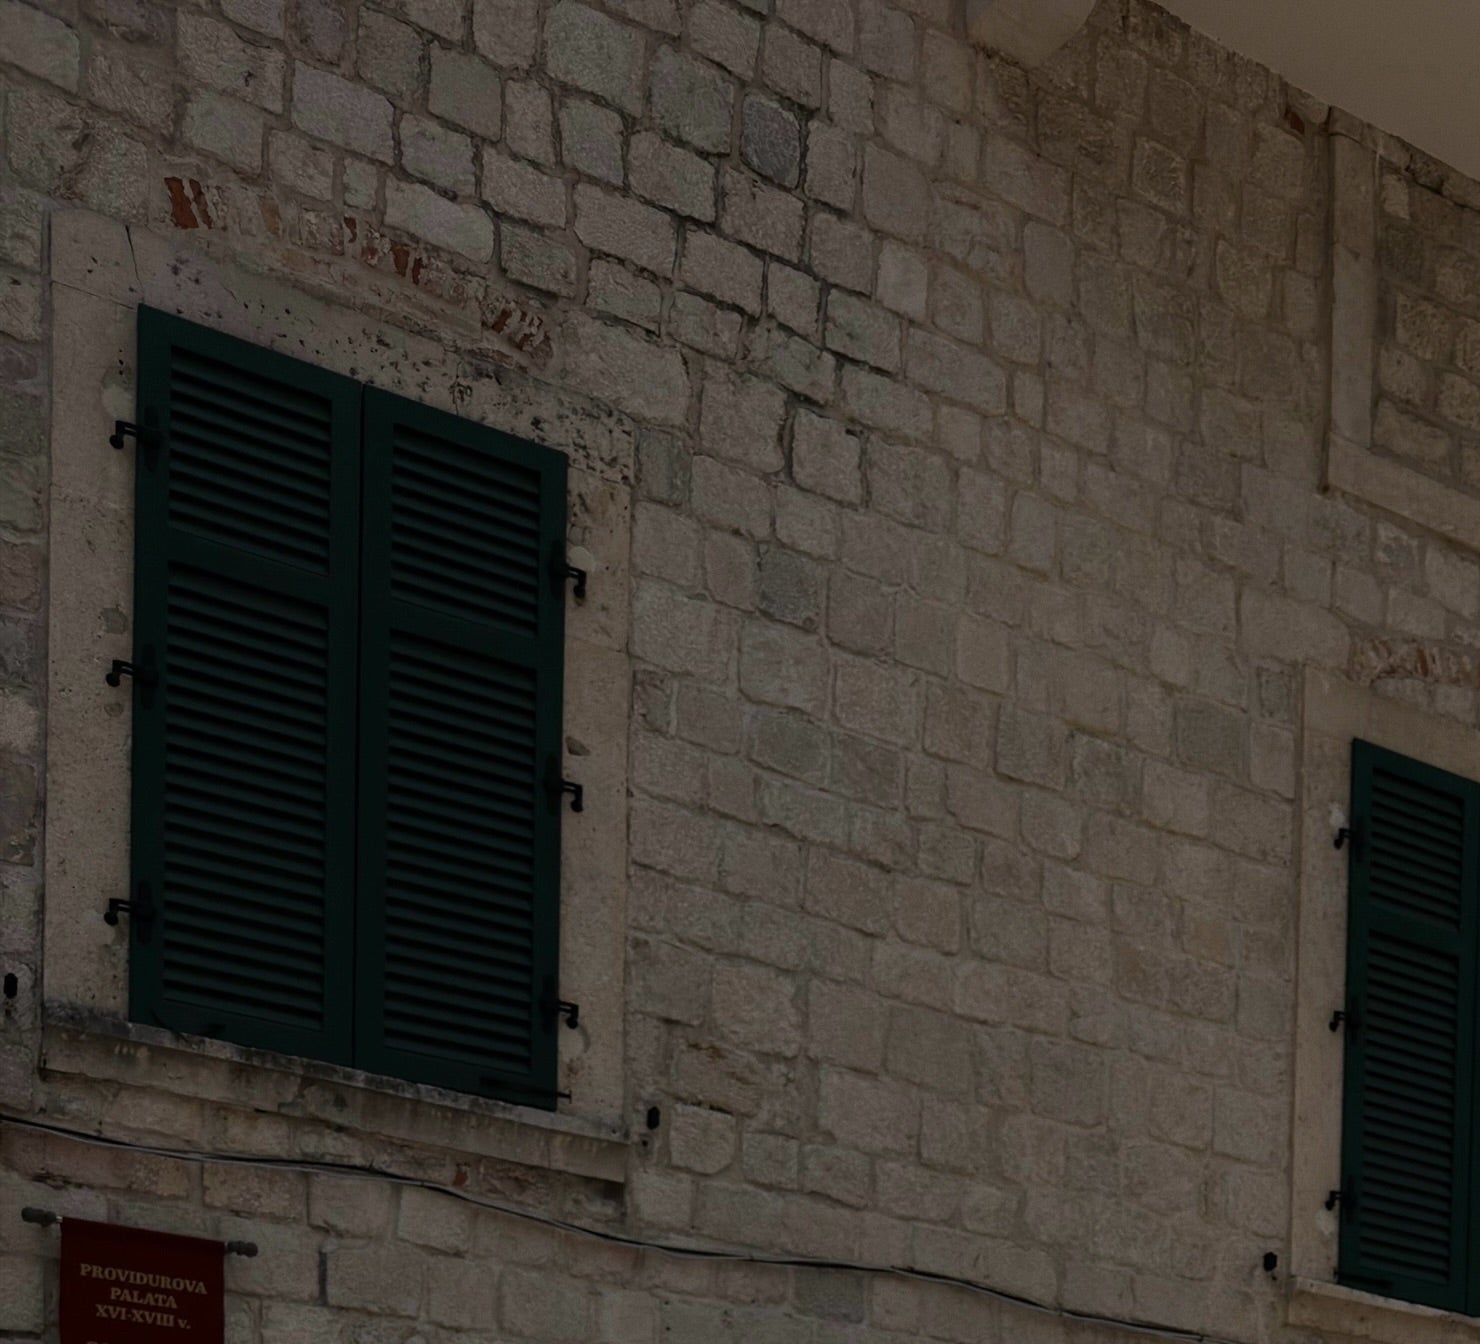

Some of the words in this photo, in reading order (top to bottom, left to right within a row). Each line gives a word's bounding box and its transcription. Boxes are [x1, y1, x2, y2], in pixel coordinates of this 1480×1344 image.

[80, 1263, 208, 1294] PROVIDUROVA
[110, 1287, 178, 1309] PALATA
[95, 1304, 175, 1328] XVI-XVIII
[177, 1318, 191, 1329] v.
